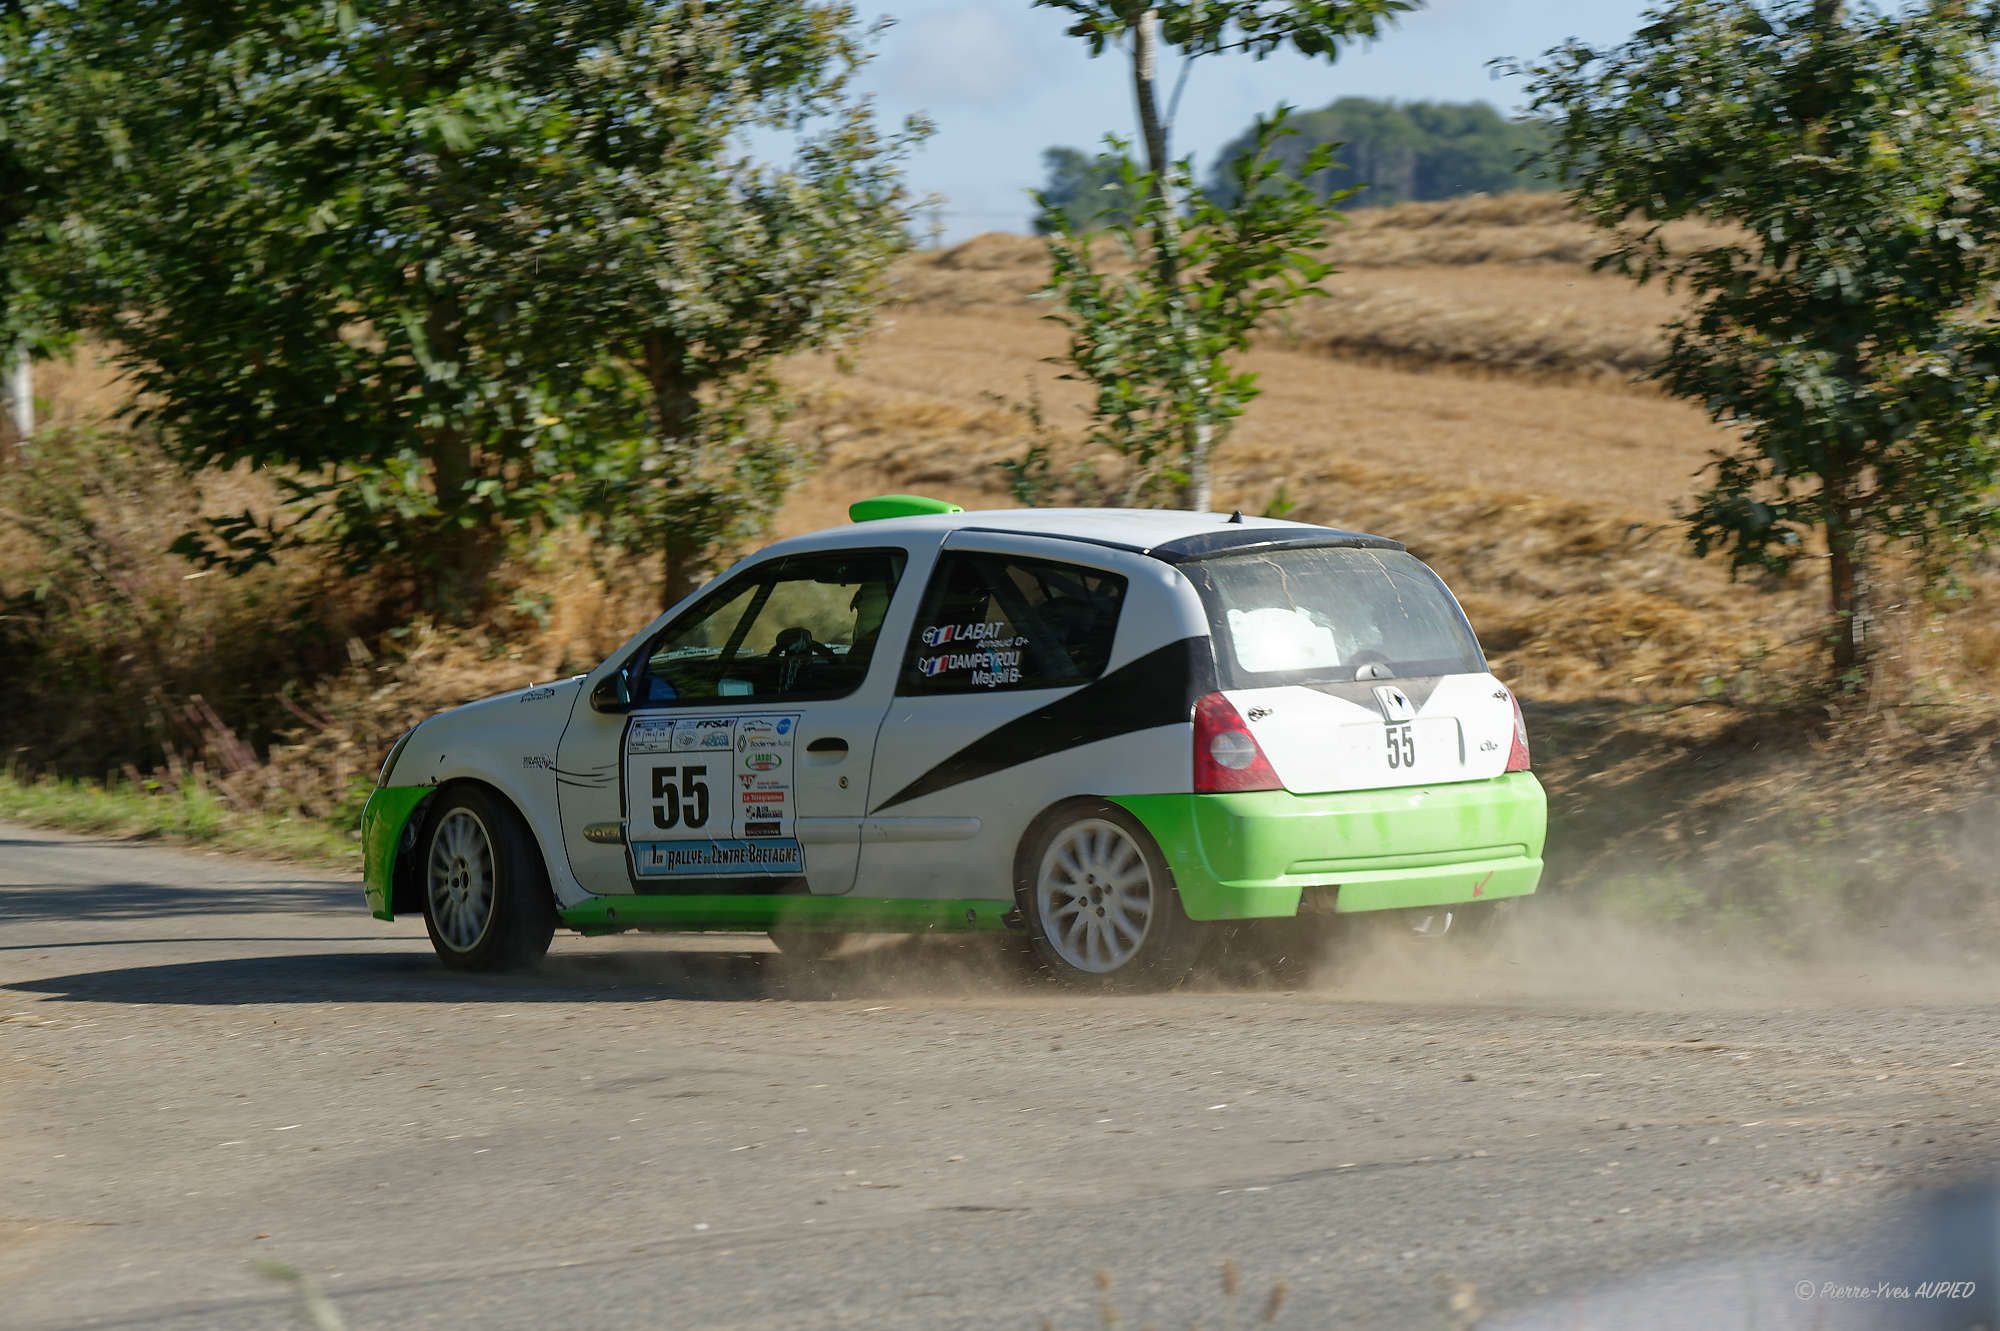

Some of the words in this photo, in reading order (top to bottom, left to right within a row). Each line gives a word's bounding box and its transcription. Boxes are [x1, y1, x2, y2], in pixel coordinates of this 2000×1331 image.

[954, 622, 1004, 640] LABAT
[948, 651, 1020, 669] DAMPEYROU
[971, 669, 1008, 687] Magali
[696, 720, 730, 729] FFSA
[1386, 726, 1415, 769] 55
[652, 765, 710, 829] 55
[668, 850, 702, 870] RALLYE
